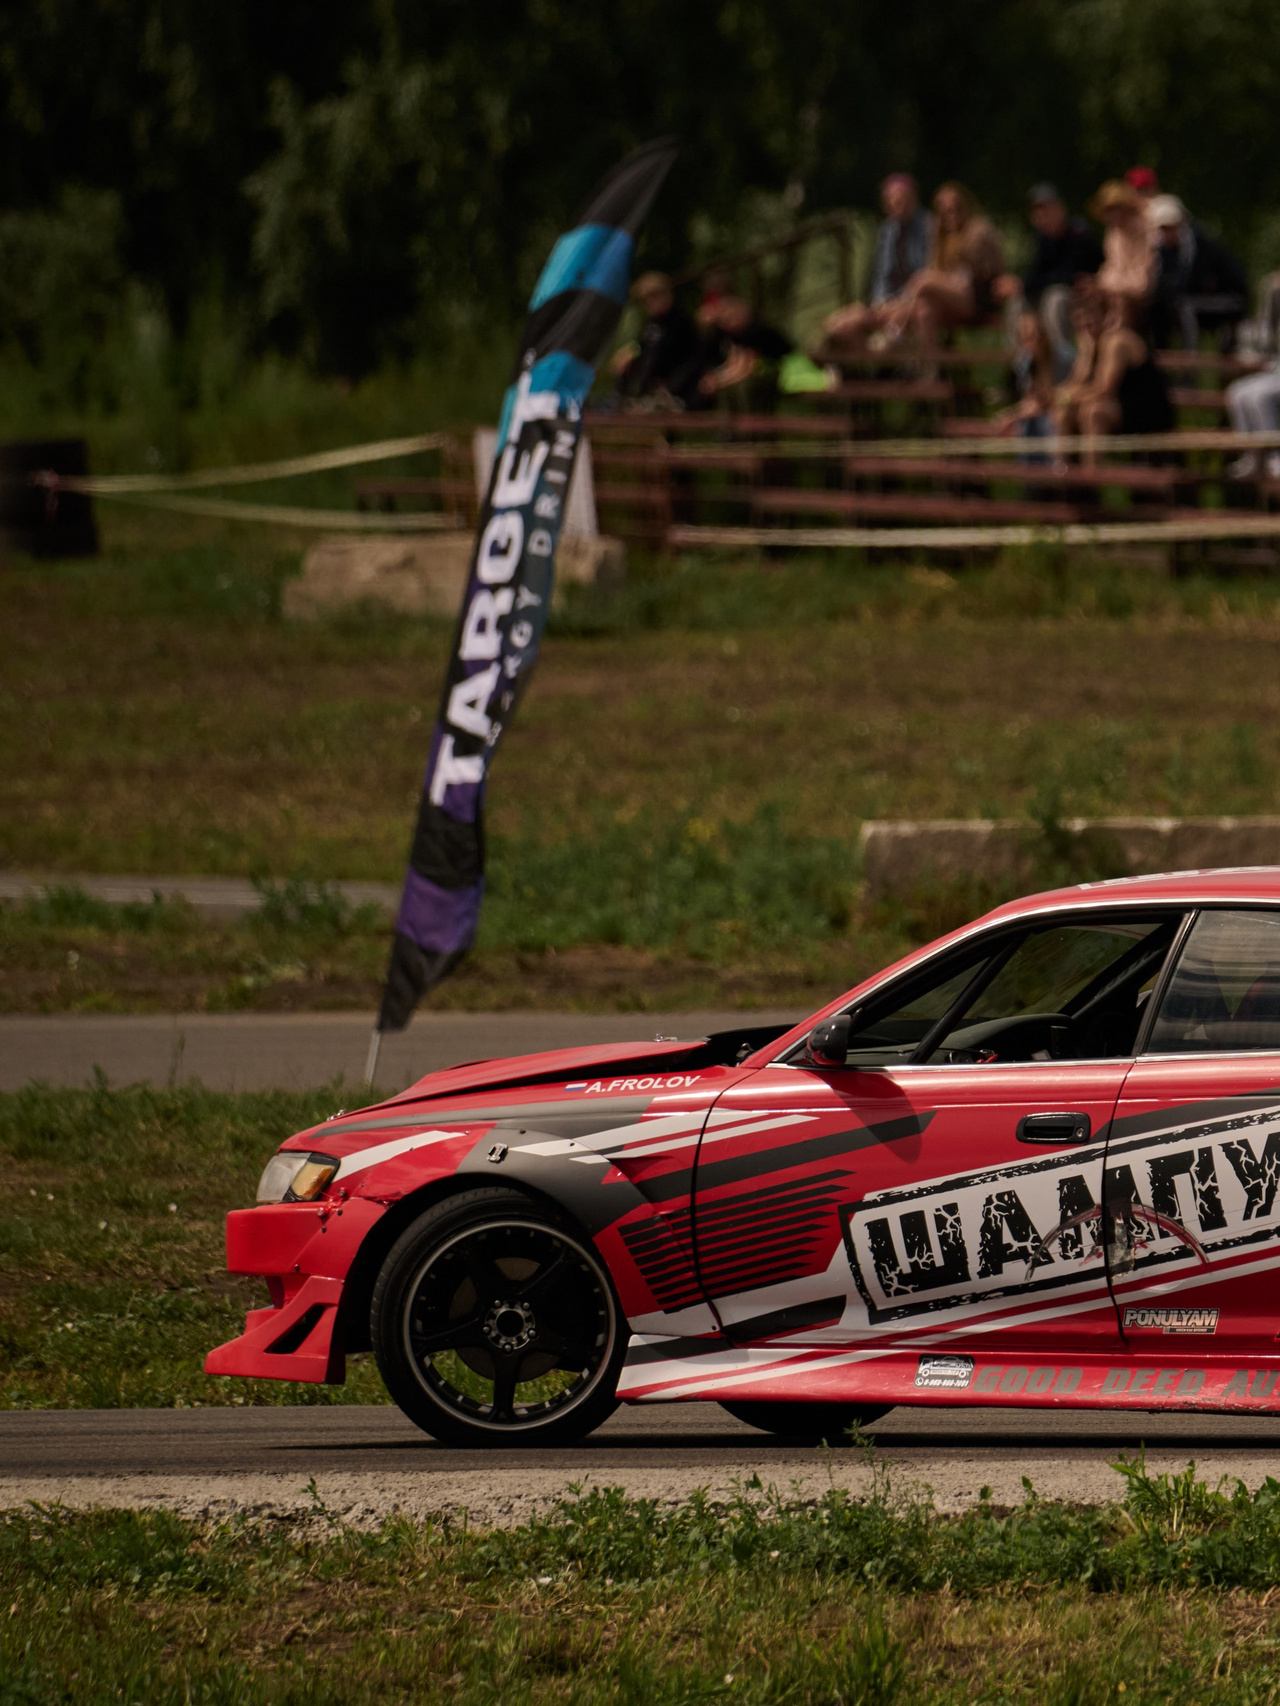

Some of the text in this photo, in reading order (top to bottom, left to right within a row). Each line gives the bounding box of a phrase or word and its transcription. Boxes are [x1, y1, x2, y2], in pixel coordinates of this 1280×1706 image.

[528, 392, 584, 557] DRINK
[430, 370, 560, 806] TARGET
[585, 1075, 701, 1094] A.FROLOV
[1123, 1308, 1219, 1328] PONULYAM
